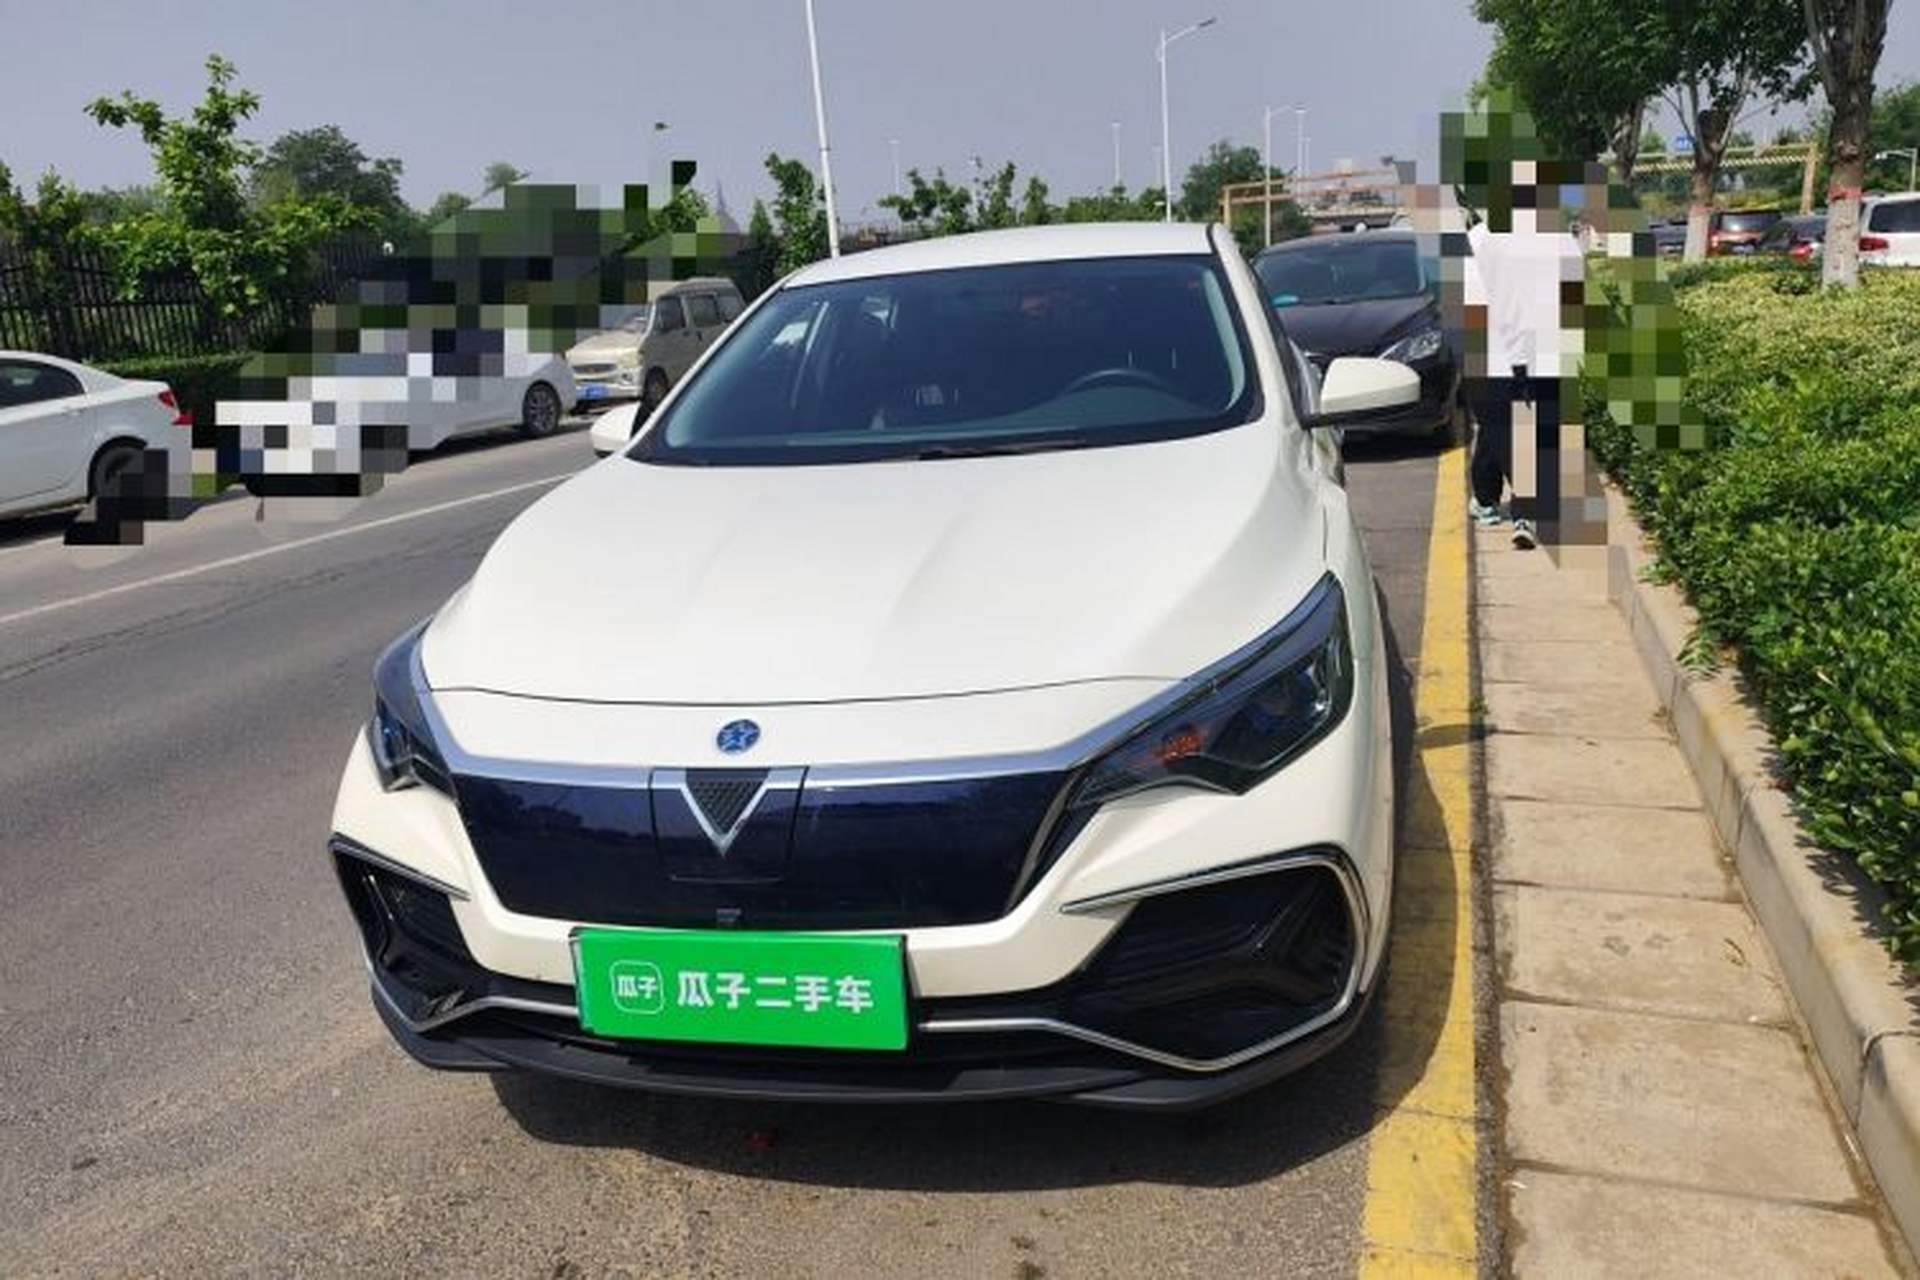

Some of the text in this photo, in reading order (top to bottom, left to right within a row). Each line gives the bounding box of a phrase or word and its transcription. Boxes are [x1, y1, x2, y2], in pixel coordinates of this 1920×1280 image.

[617, 975, 658, 999] 瓜子
[677, 971, 874, 1013] 瓜子二手车
